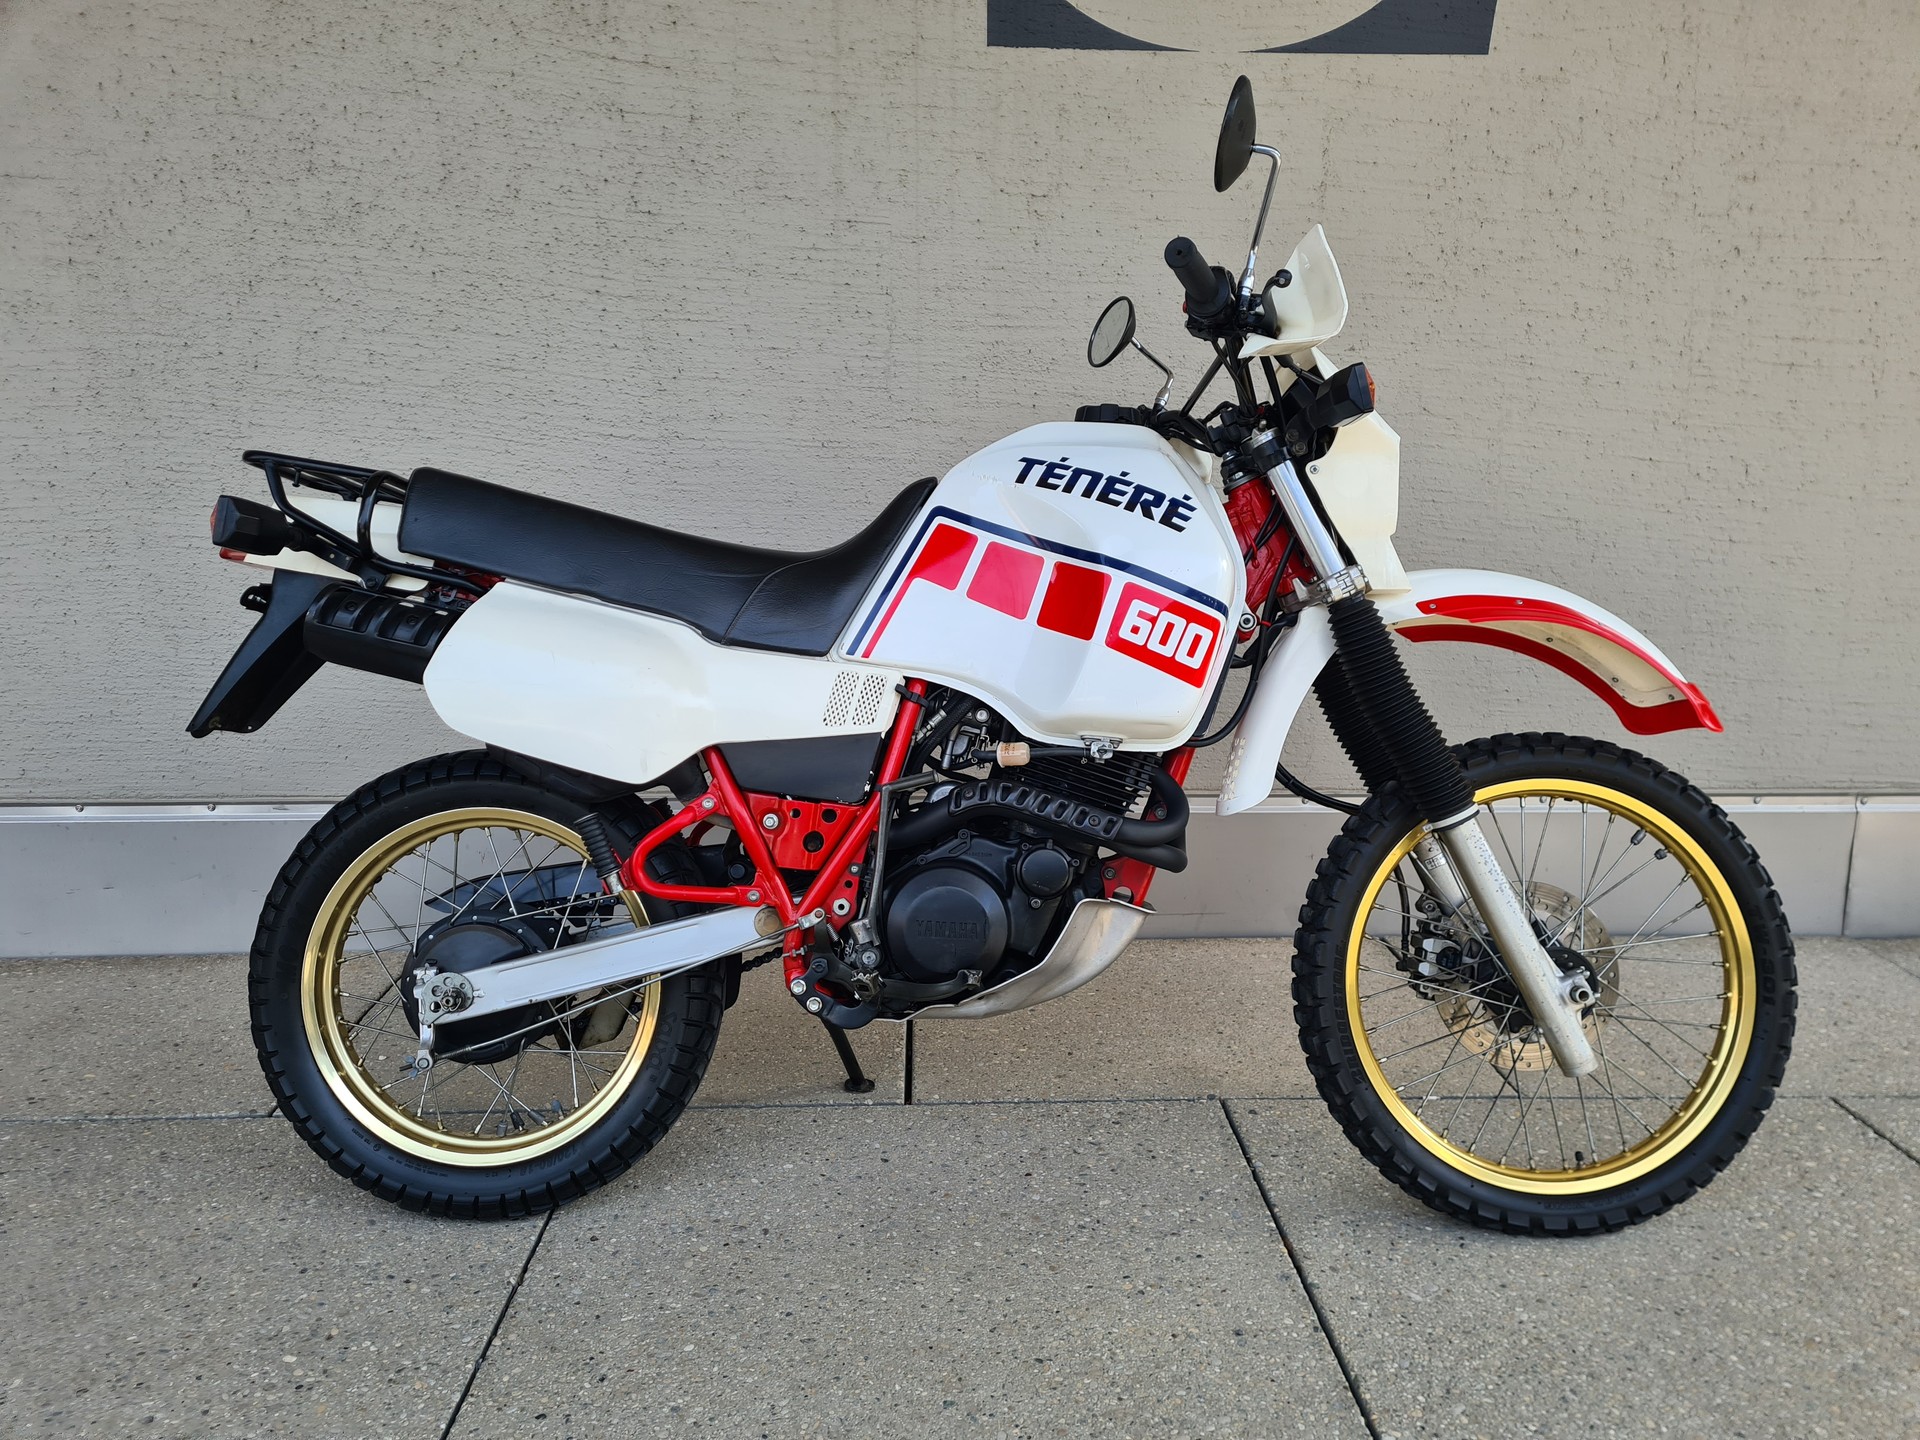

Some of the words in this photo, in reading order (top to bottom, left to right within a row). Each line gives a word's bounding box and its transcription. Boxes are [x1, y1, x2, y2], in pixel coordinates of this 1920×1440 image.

[1014, 456, 1198, 533] TÉNÉRÉ
[1118, 599, 1214, 670] 600
[914, 919, 978, 939] YAMAHA
